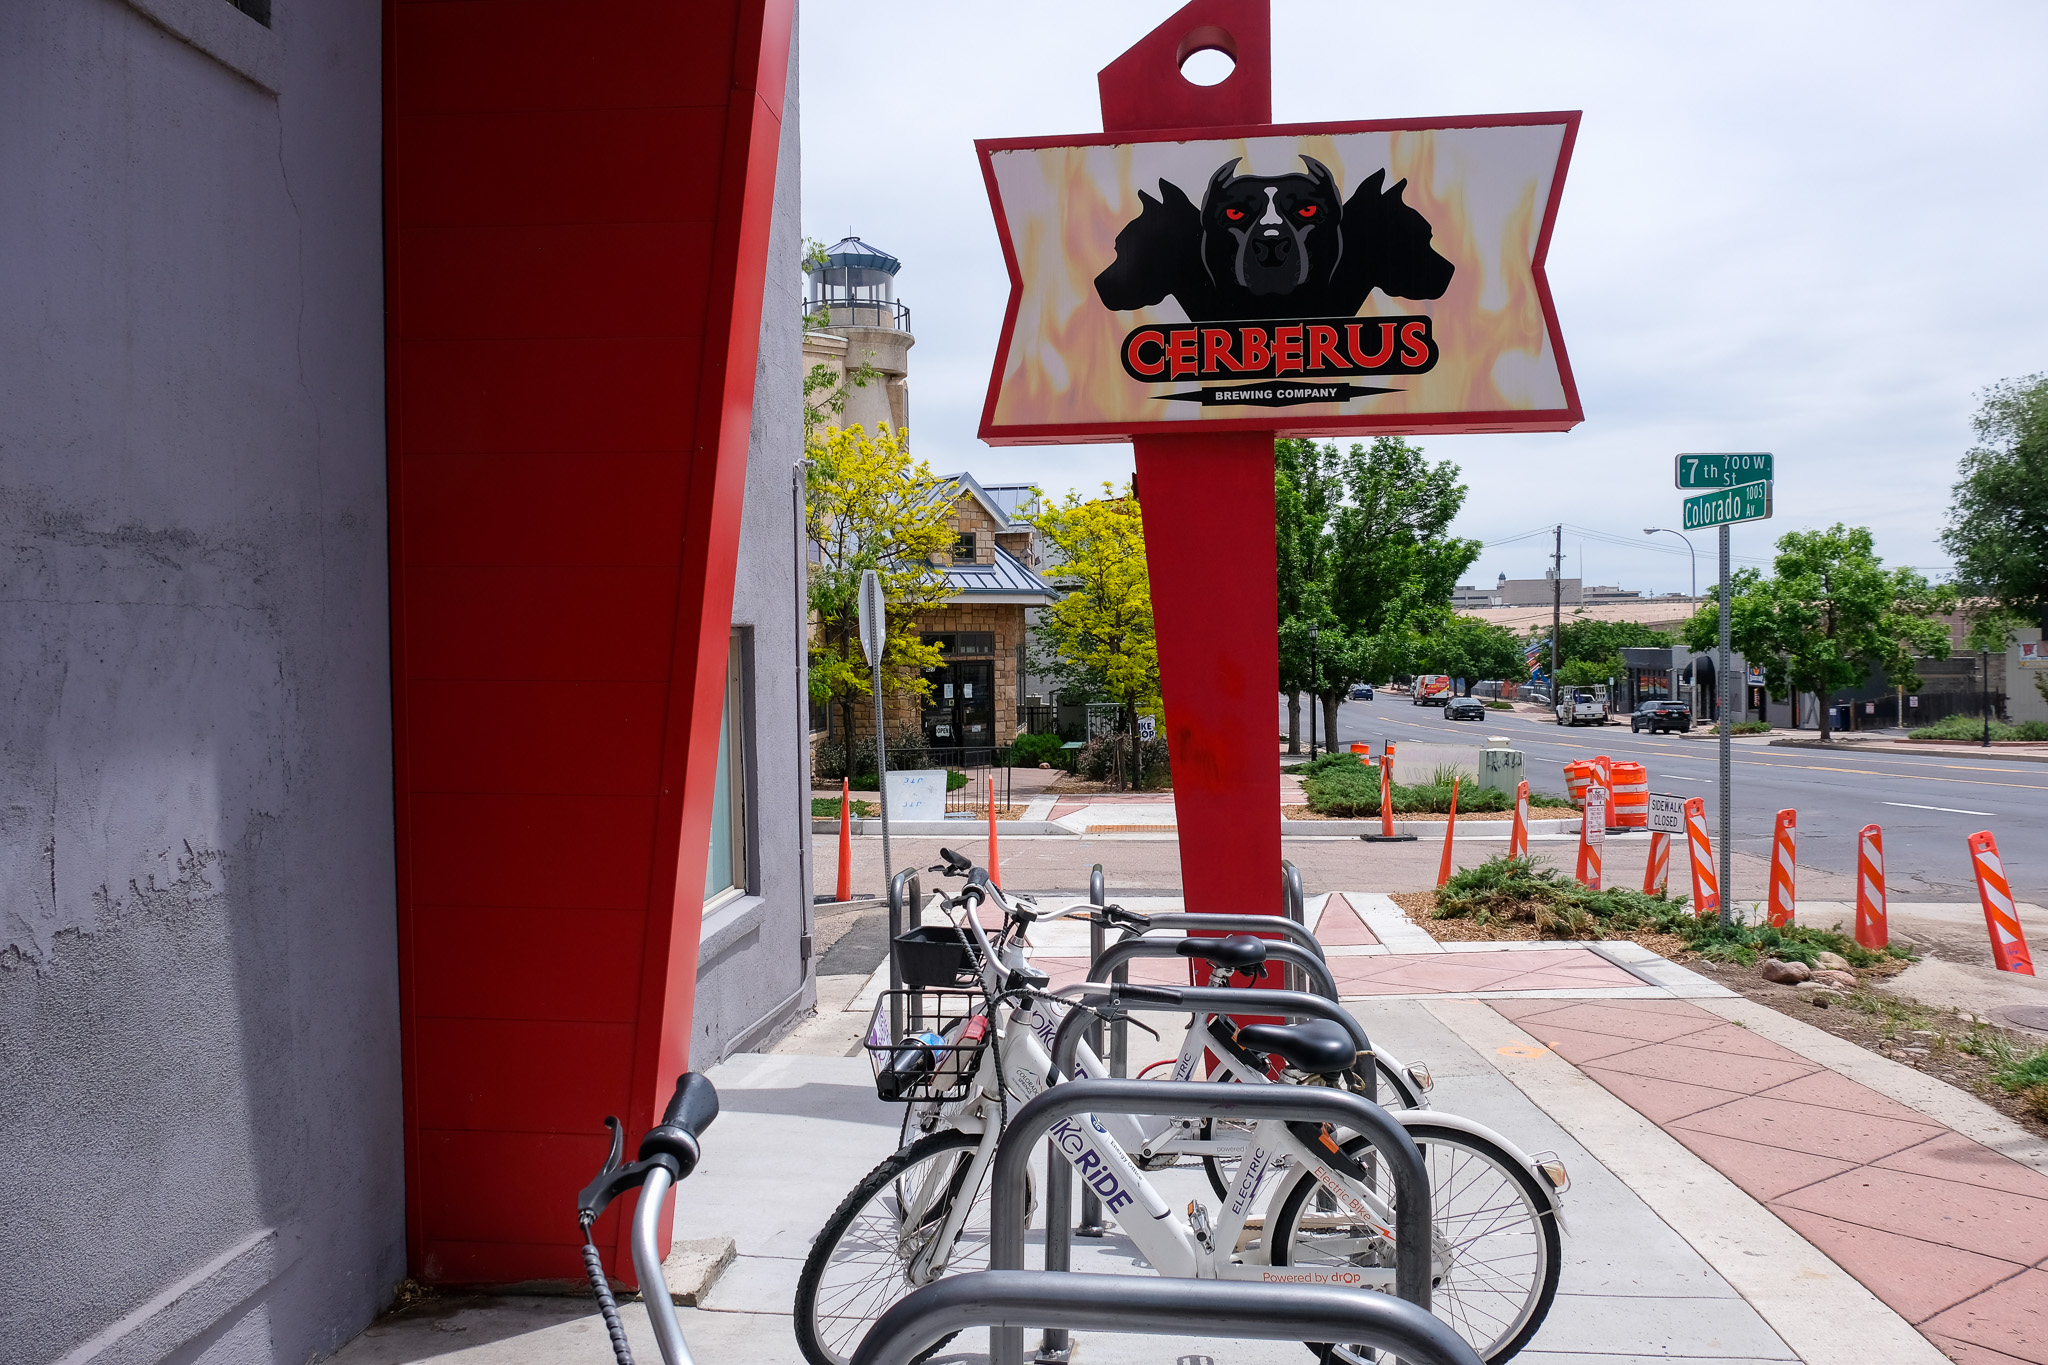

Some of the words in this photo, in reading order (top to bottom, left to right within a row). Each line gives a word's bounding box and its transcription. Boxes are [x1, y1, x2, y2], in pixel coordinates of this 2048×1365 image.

[1128, 321, 1432, 380] CERBERUS
[1215, 390, 1273, 401] BREWING
[1276, 388, 1338, 399] COMPANY
[1723, 472, 1737, 486] St
[1685, 491, 1741, 527] Colorado
[1138, 722, 1152, 730] IKE
[1651, 799, 1683, 814] SIDEWALK
[1654, 814, 1678, 828] CLOSED
[1175, 1052, 1192, 1081] TRIC
[1110, 1140, 1128, 1163] Energy
[1127, 1162, 1143, 1181] Office
[1232, 1147, 1265, 1215] ELECTRIC
[1314, 1166, 1350, 1201] Electric
[1349, 1198, 1371, 1221] Bike
[1263, 1272, 1312, 1283] Powered
[1314, 1272, 1329, 1284] by
